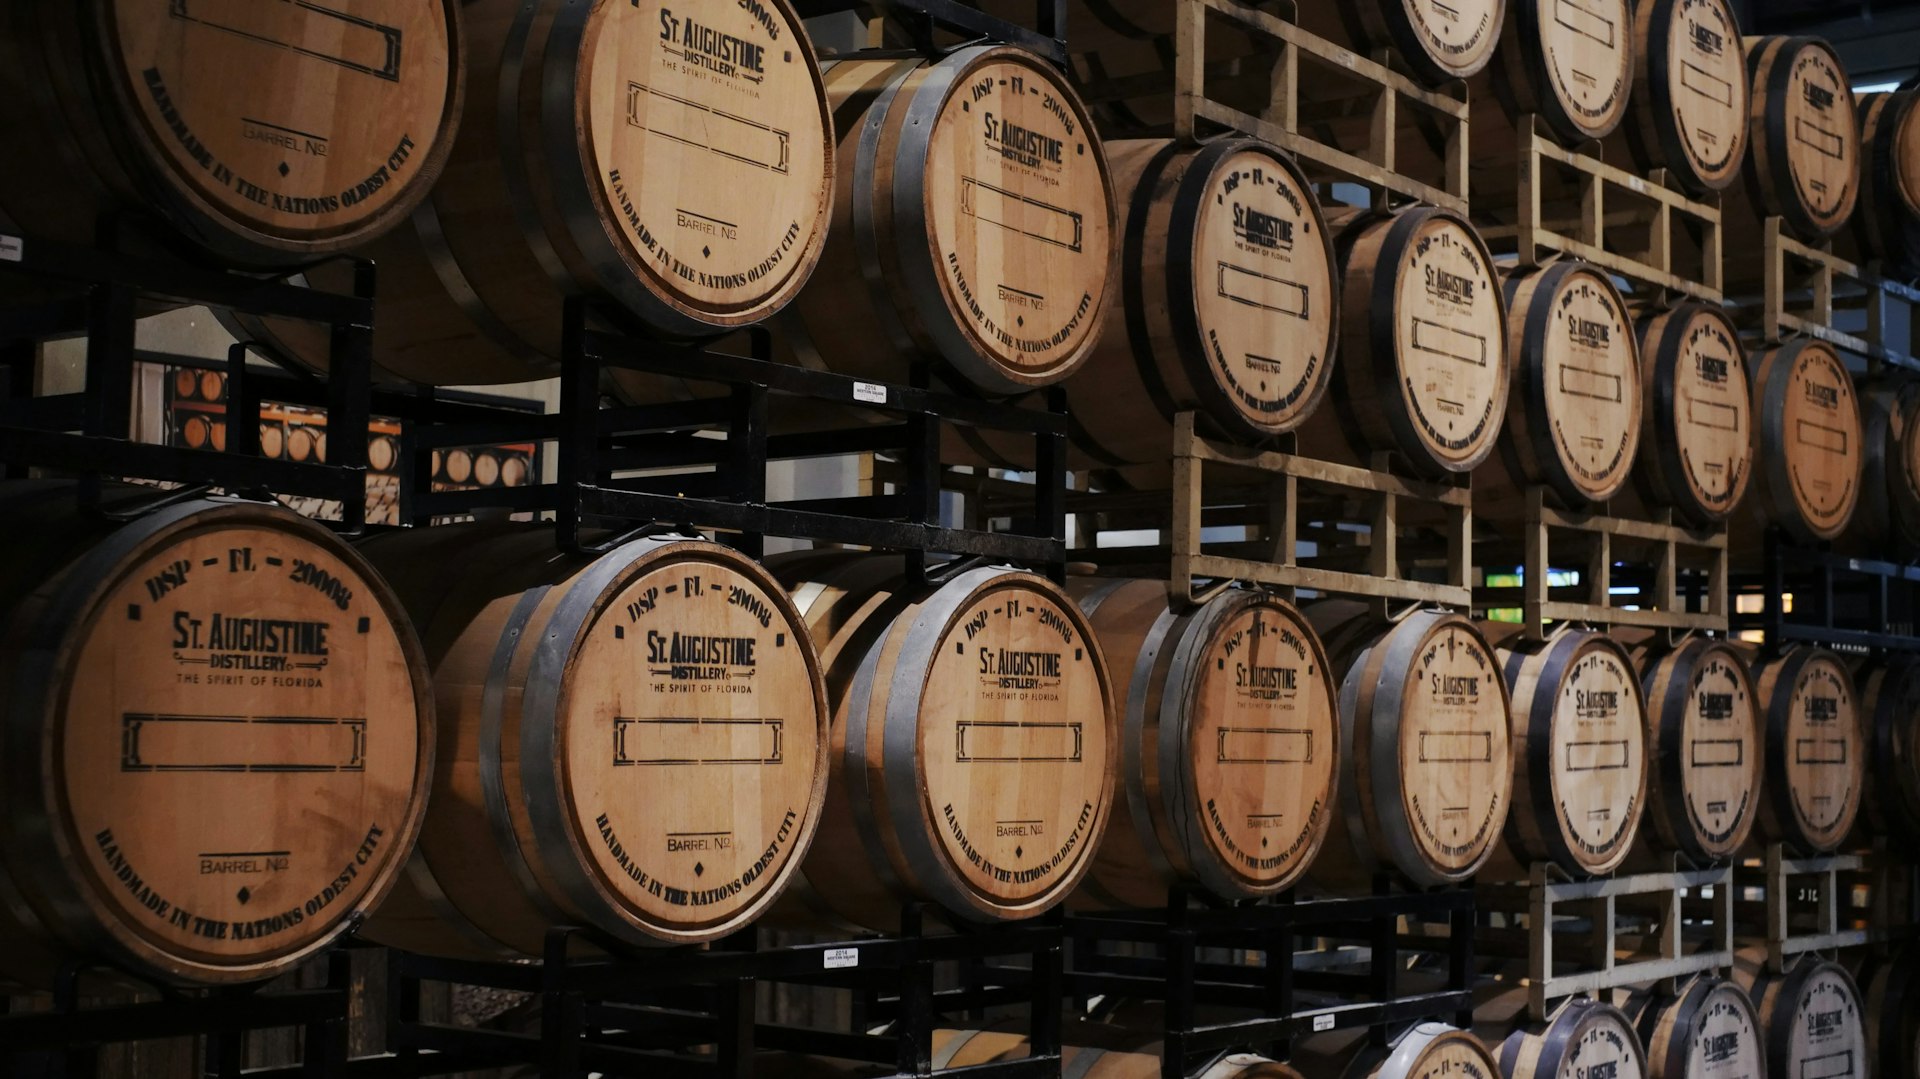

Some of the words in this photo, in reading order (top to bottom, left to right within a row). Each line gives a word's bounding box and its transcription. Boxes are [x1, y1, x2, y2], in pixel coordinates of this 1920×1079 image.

[660, 8, 680, 44] ST.
[683, 17, 764, 74] AUGUSTINE
[662, 59, 677, 71] THE
[684, 49, 736, 77] DISTILLERY
[243, 123, 300, 152] BARREL
[985, 112, 999, 142] ST.
[1001, 119, 1063, 164] AUGUSTINE
[1001, 146, 1041, 170] DISTILLERY
[212, 163, 234, 186] IN
[235, 178, 268, 206] THE
[271, 194, 339, 215] NATIONS
[341, 166, 391, 208] OLDEST
[388, 133, 416, 172] CITY
[609, 170, 658, 253] HANDMADE
[657, 247, 671, 266] IN
[672, 259, 696, 282] THE
[699, 272, 747, 289] NATIONS
[748, 247, 783, 283] OLDEST
[780, 220, 801, 252] CITY
[677, 214, 718, 236] BARREL
[1246, 206, 1293, 243] AUGUSTINE
[949, 252, 985, 323] HANDMADE
[984, 318, 996, 335] IN
[996, 327, 1013, 348] THE
[1016, 338, 1052, 353] NATIONS
[1051, 315, 1079, 346] OLDEST
[627, 586, 659, 623] DSP
[173, 610, 204, 649] ST.
[209, 613, 330, 655] AUGUSTINE
[647, 629, 668, 664] ST.
[669, 631, 756, 666] AUGUSTINE
[210, 653, 288, 671] DISTILLERY
[671, 665, 727, 680] DISTILLERY
[980, 647, 996, 674] ST.
[998, 648, 1061, 677] AUGUSTINE
[1236, 662, 1248, 687] ST.
[1249, 664, 1296, 689] AUGUSTINE
[176, 673, 199, 685] THE
[207, 674, 244, 686] SPIRIT
[251, 676, 267, 686] OF
[273, 676, 323, 688] FLORIDA
[649, 683, 665, 693] THE
[669, 683, 696, 693] SPIRIT
[700, 684, 712, 693] OF
[716, 684, 752, 694] FLORIDA
[999, 677, 1040, 689] DISTILLERY
[982, 691, 994, 699] THE
[997, 692, 1017, 700] SPIRIT
[1019, 692, 1029, 700] OF
[1031, 693, 1059, 701] FLORIDA
[667, 838, 711, 852] BARREL
[944, 803, 982, 868] HANDMADE
[981, 858, 993, 876] IN
[994, 867, 1011, 884] THE
[1013, 861, 1051, 884] NATIONS
[1051, 829, 1080, 867] OLDEST
[1077, 800, 1092, 831] CITY
[996, 825, 1028, 837] BARREL
[200, 858, 262, 875] BARREL
[596, 812, 646, 888] HANDMADE
[648, 879, 663, 898] IN
[664, 886, 688, 906] THE
[690, 879, 742, 906] NATIONS
[742, 841, 780, 887] OLDEST
[777, 807, 797, 843] CITY
[1236, 849, 1245, 863] IN
[1245, 854, 1258, 869] THE
[1260, 853, 1289, 870] NATIONS
[95, 828, 170, 919] HANDMADE
[169, 907, 192, 931] IN
[193, 916, 226, 940] THE
[231, 906, 304, 941] NATIONS
[305, 862, 358, 917] OLDEST
[355, 821, 384, 866] CITY
